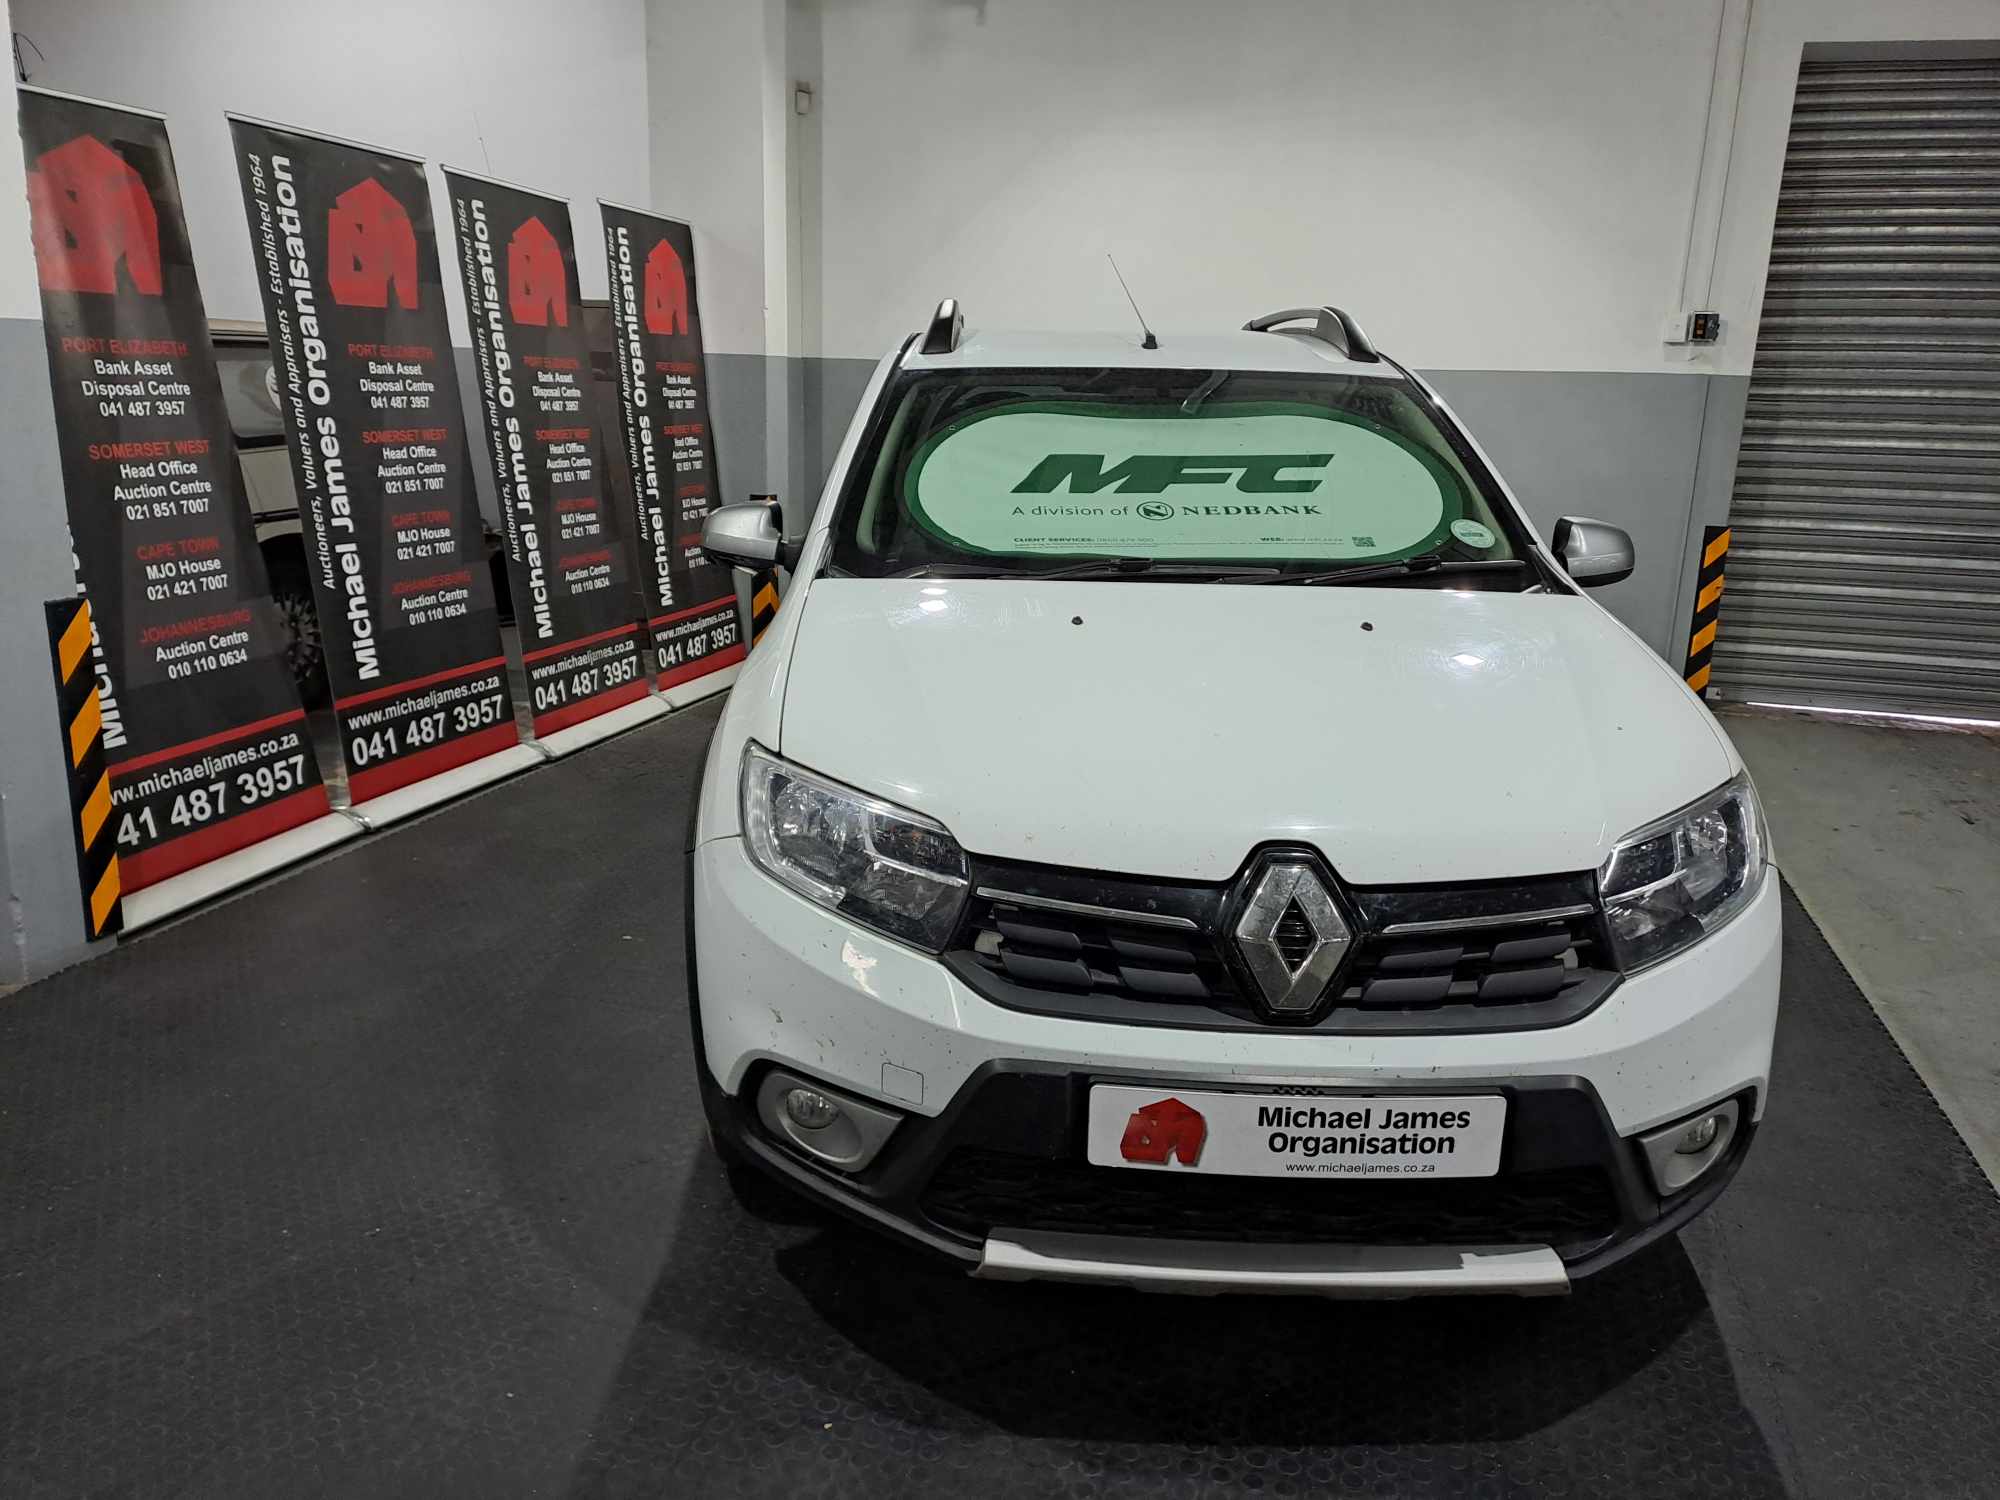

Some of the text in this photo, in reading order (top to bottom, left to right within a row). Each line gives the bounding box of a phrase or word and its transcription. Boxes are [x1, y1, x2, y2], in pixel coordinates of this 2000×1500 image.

[249, 153, 266, 195] 1964
[255, 200, 283, 295] Established
[463, 238, 481, 316] Established
[61, 337, 104, 353] PORT
[276, 308, 302, 394] Appraisers
[94, 359, 173, 375] Bank Asset
[368, 361, 422, 375] Bank Asset
[477, 327, 494, 396] Appraisers
[81, 381, 190, 398] Disposal Centre
[360, 379, 434, 394] Disposal Centre
[100, 401, 185, 416] 041 487 3957
[290, 396, 307, 428] and
[371, 396, 430, 409] 041 487 3957
[487, 398, 500, 427] and
[271, 154, 380, 681] Michael James Organisation
[471, 199, 553, 639] Michael James Organisation
[617, 226, 674, 607] Michael James Organisation
[89, 440, 209, 460] SOMERSET WEST
[298, 432, 317, 490] Valuers
[383, 445, 437, 460] Head Office
[491, 429, 507, 478] Valuers
[120, 460, 198, 479] Head Office
[377, 462, 446, 478] Auction Centre
[1009, 453, 1336, 494] MFC
[114, 479, 212, 501] Auction Centre
[386, 477, 444, 494] 021 851 7007
[126, 499, 209, 520] 021 851 7007
[1012, 504, 1322, 517] A division of NEDBANK
[310, 494, 336, 590] Auctioneers,
[397, 528, 451, 543] MJO House
[397, 540, 455, 560] 021 421 7007
[146, 558, 221, 580] MJO House
[147, 574, 228, 601] 021 421 7007
[401, 588, 469, 611] Auction Centre
[409, 603, 467, 626] 010 110 0634
[155, 630, 249, 662] Auction Centre
[658, 623, 736, 668] 041 487 3957
[168, 648, 248, 679] 010 110 0634
[531, 640, 635, 680] www.michaeljames.co.za
[535, 655, 637, 710] 041 487 3957
[348, 675, 499, 730] www.michaeljames.co.za
[352, 694, 503, 766] 041 487 3957
[111, 732, 299, 806] w.michaeljames.co.za
[117, 754, 304, 846] 41 487 3957
[1257, 1106, 1471, 1130] Michael James
[1268, 1132, 1455, 1157] Organisation
[1285, 1162, 1435, 1175] www.michaeljames.co.za
